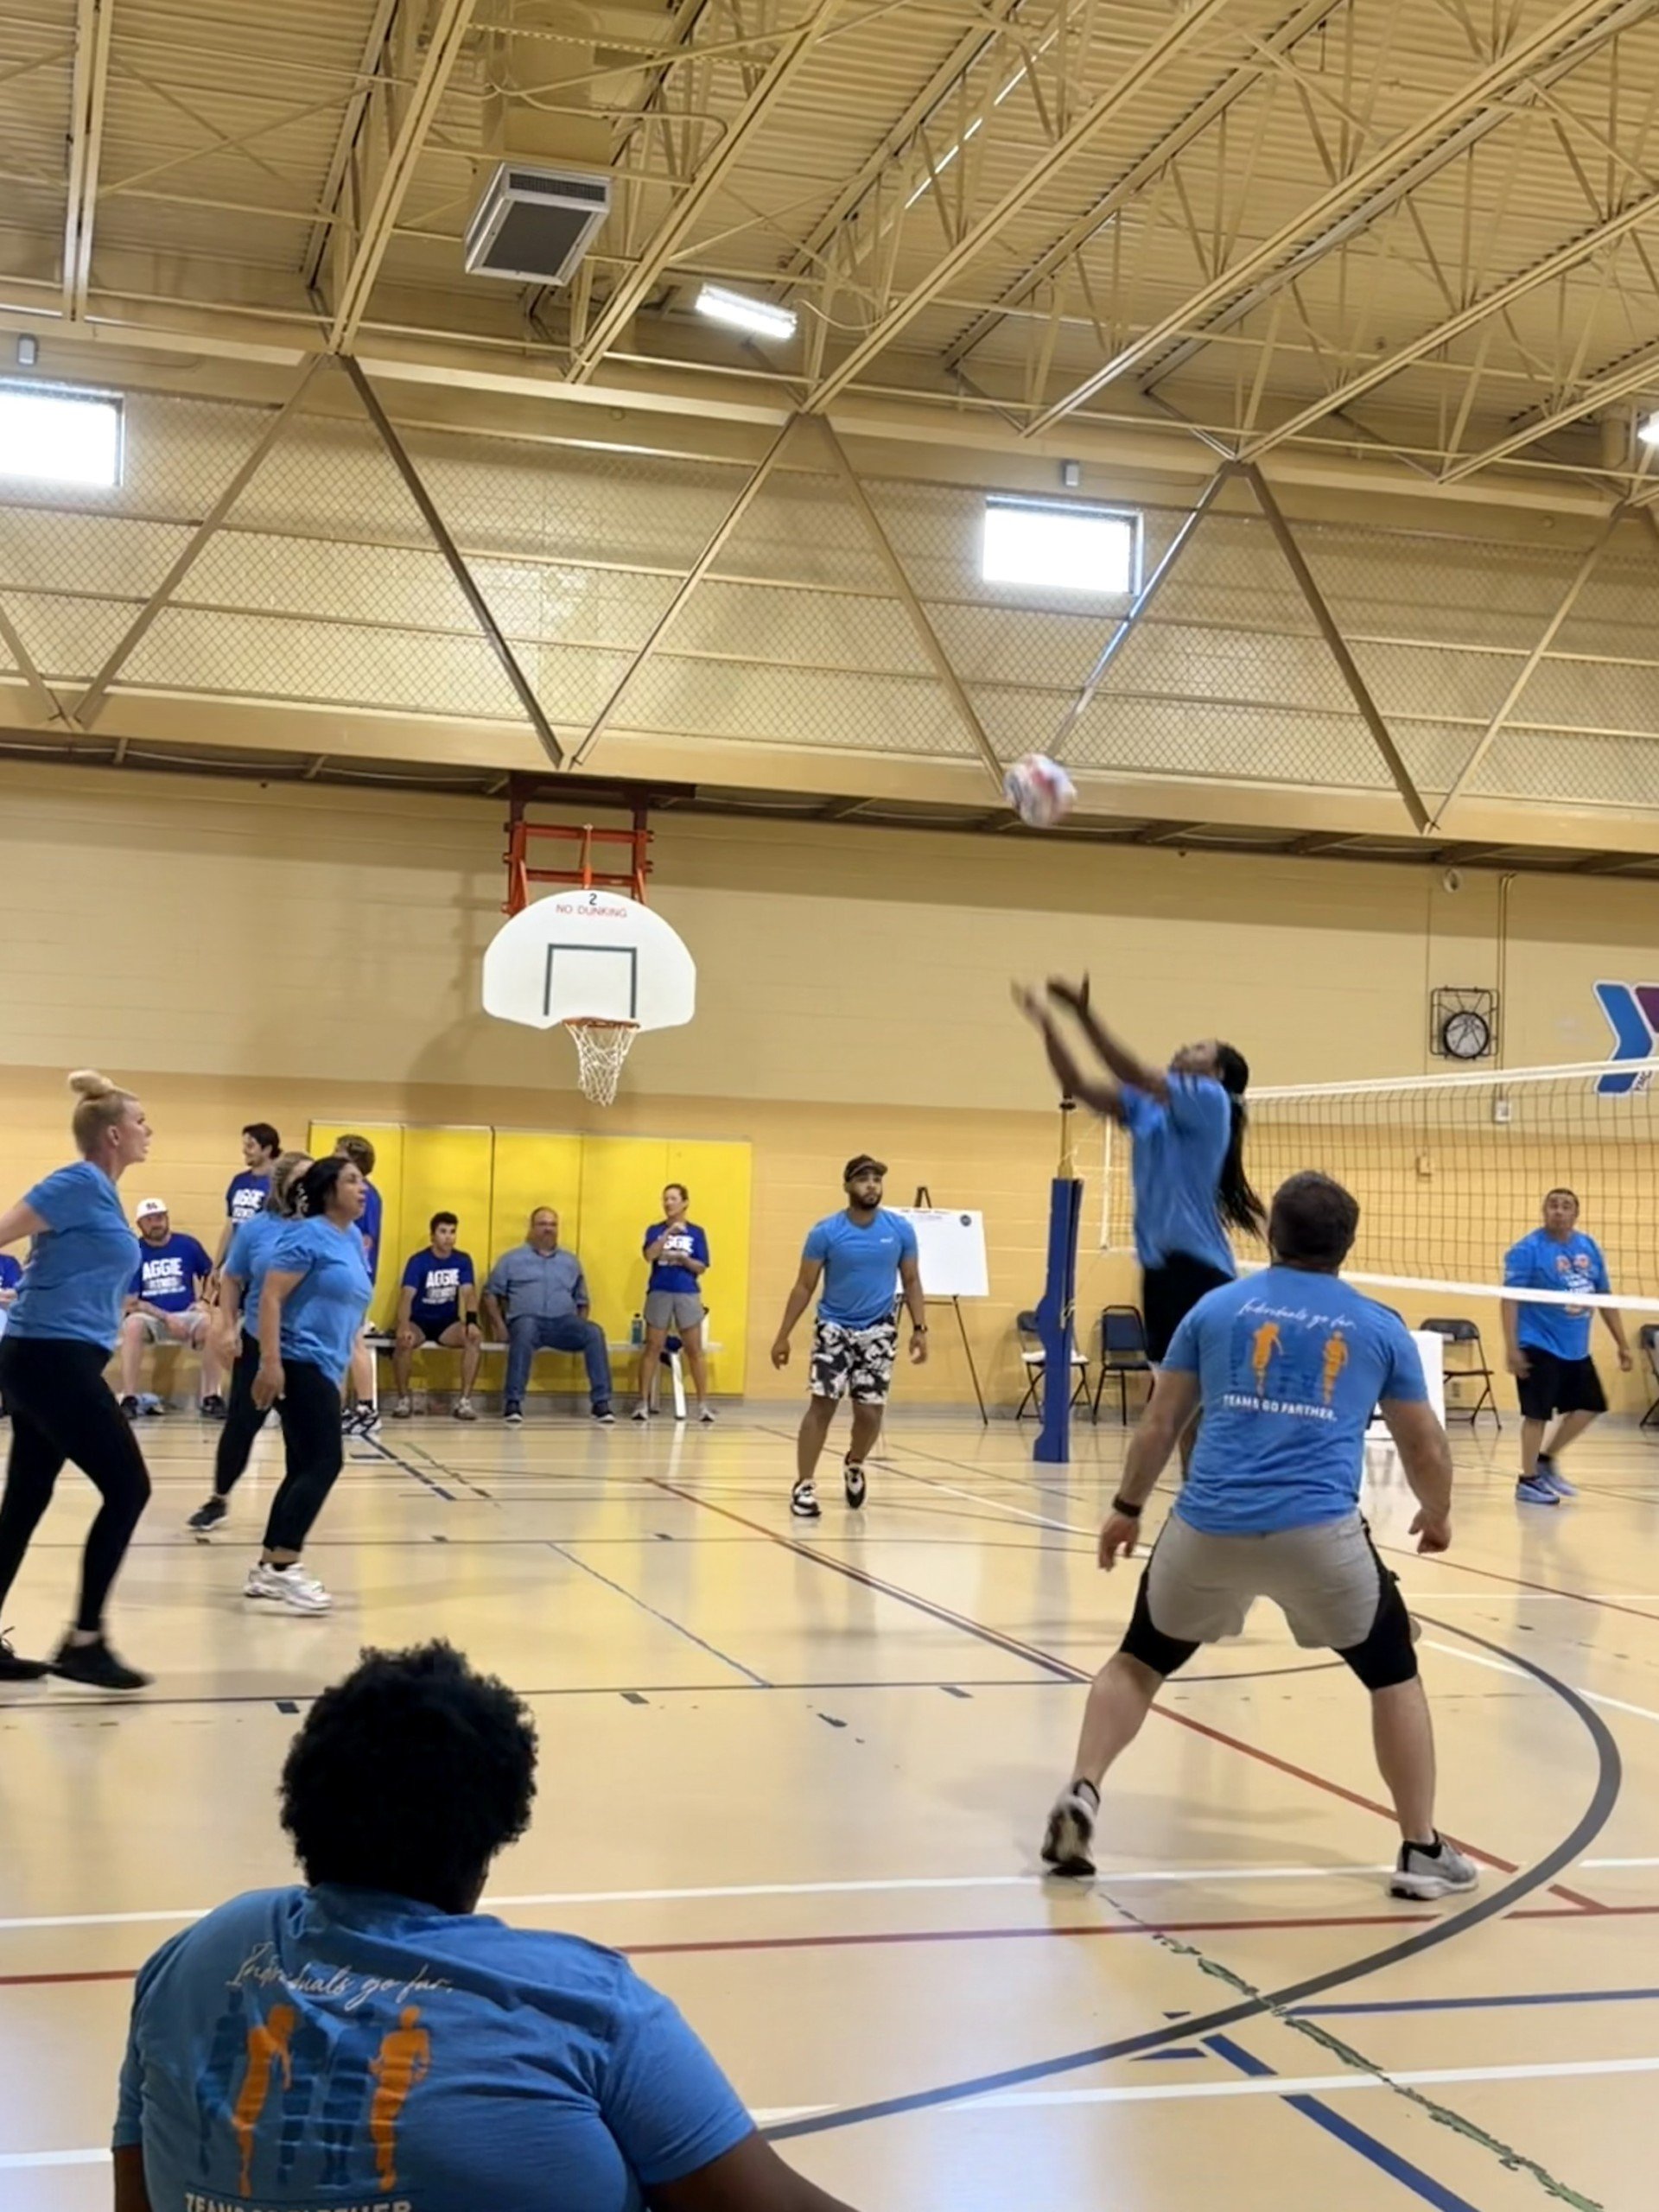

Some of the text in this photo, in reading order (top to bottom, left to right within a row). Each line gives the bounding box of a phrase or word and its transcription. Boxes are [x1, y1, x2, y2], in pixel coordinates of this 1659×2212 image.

[588, 892, 598, 906] 2
[556, 904, 628, 918] NO DUNKING
[662, 1235, 694, 1255] GGIE
[142, 1257, 183, 1281] AGGIE
[426, 1268, 460, 1288] AGGIE
[1224, 1394, 1260, 1410] TEAMS
[1262, 1399, 1279, 1414] GO
[345, 1974, 399, 2012] go
